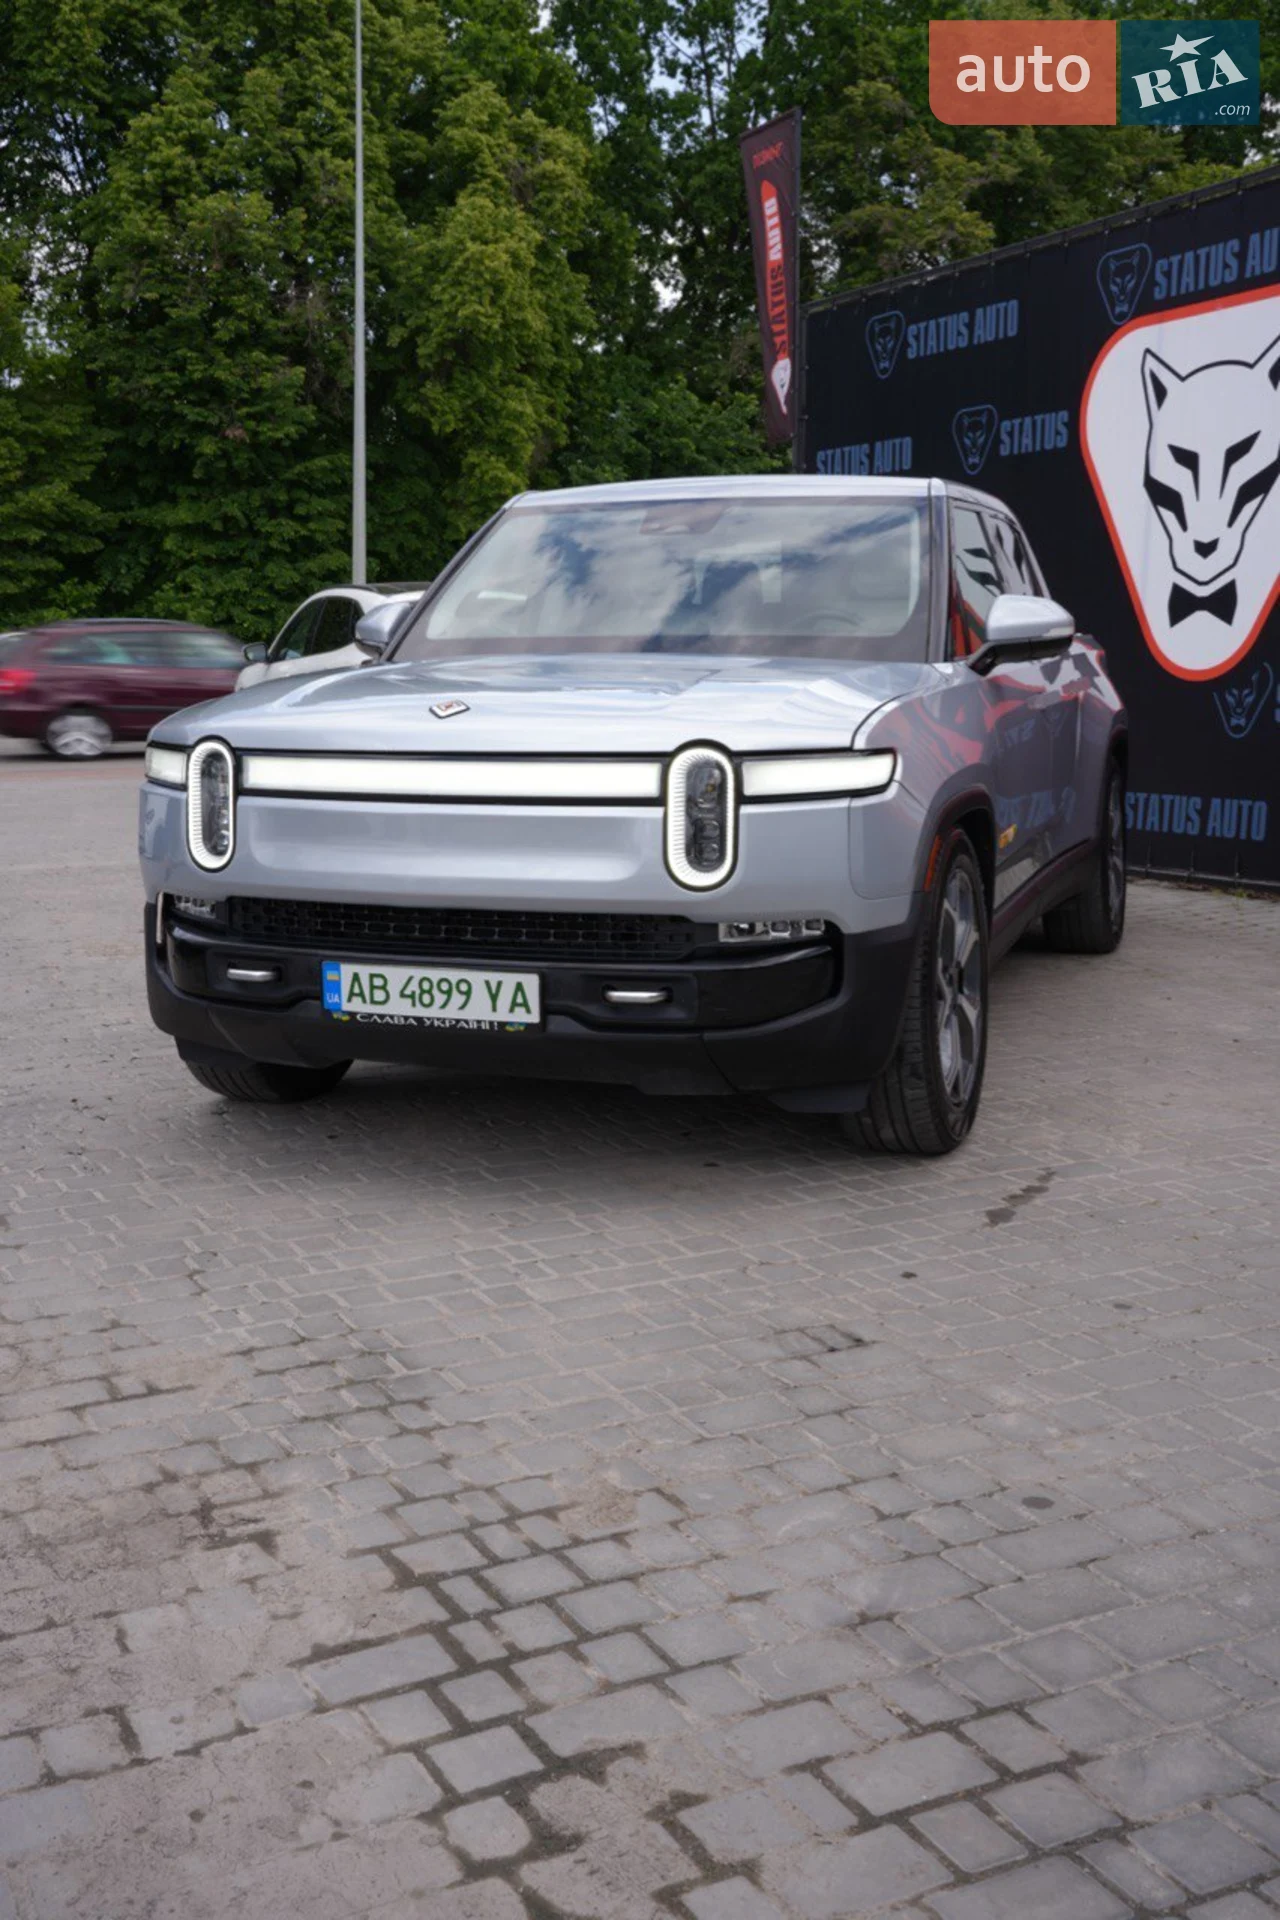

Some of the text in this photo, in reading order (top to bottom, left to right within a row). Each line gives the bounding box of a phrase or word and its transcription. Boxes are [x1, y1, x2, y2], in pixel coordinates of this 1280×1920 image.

[763, 196, 787, 356] STATUS AUTO
[1154, 238, 1240, 300] STATUS
[907, 299, 1019, 359] STATUS AUTO
[816, 436, 913, 475] STATUS AUTO
[1000, 410, 1069, 456] STATUS
[1125, 791, 1202, 836] STATUS
[1206, 797, 1268, 841] AUTO
[326, 993, 340, 1003] UA
[346, 972, 532, 1015] AB 4899 YA
[356, 1013, 418, 1026] СЛАВА
